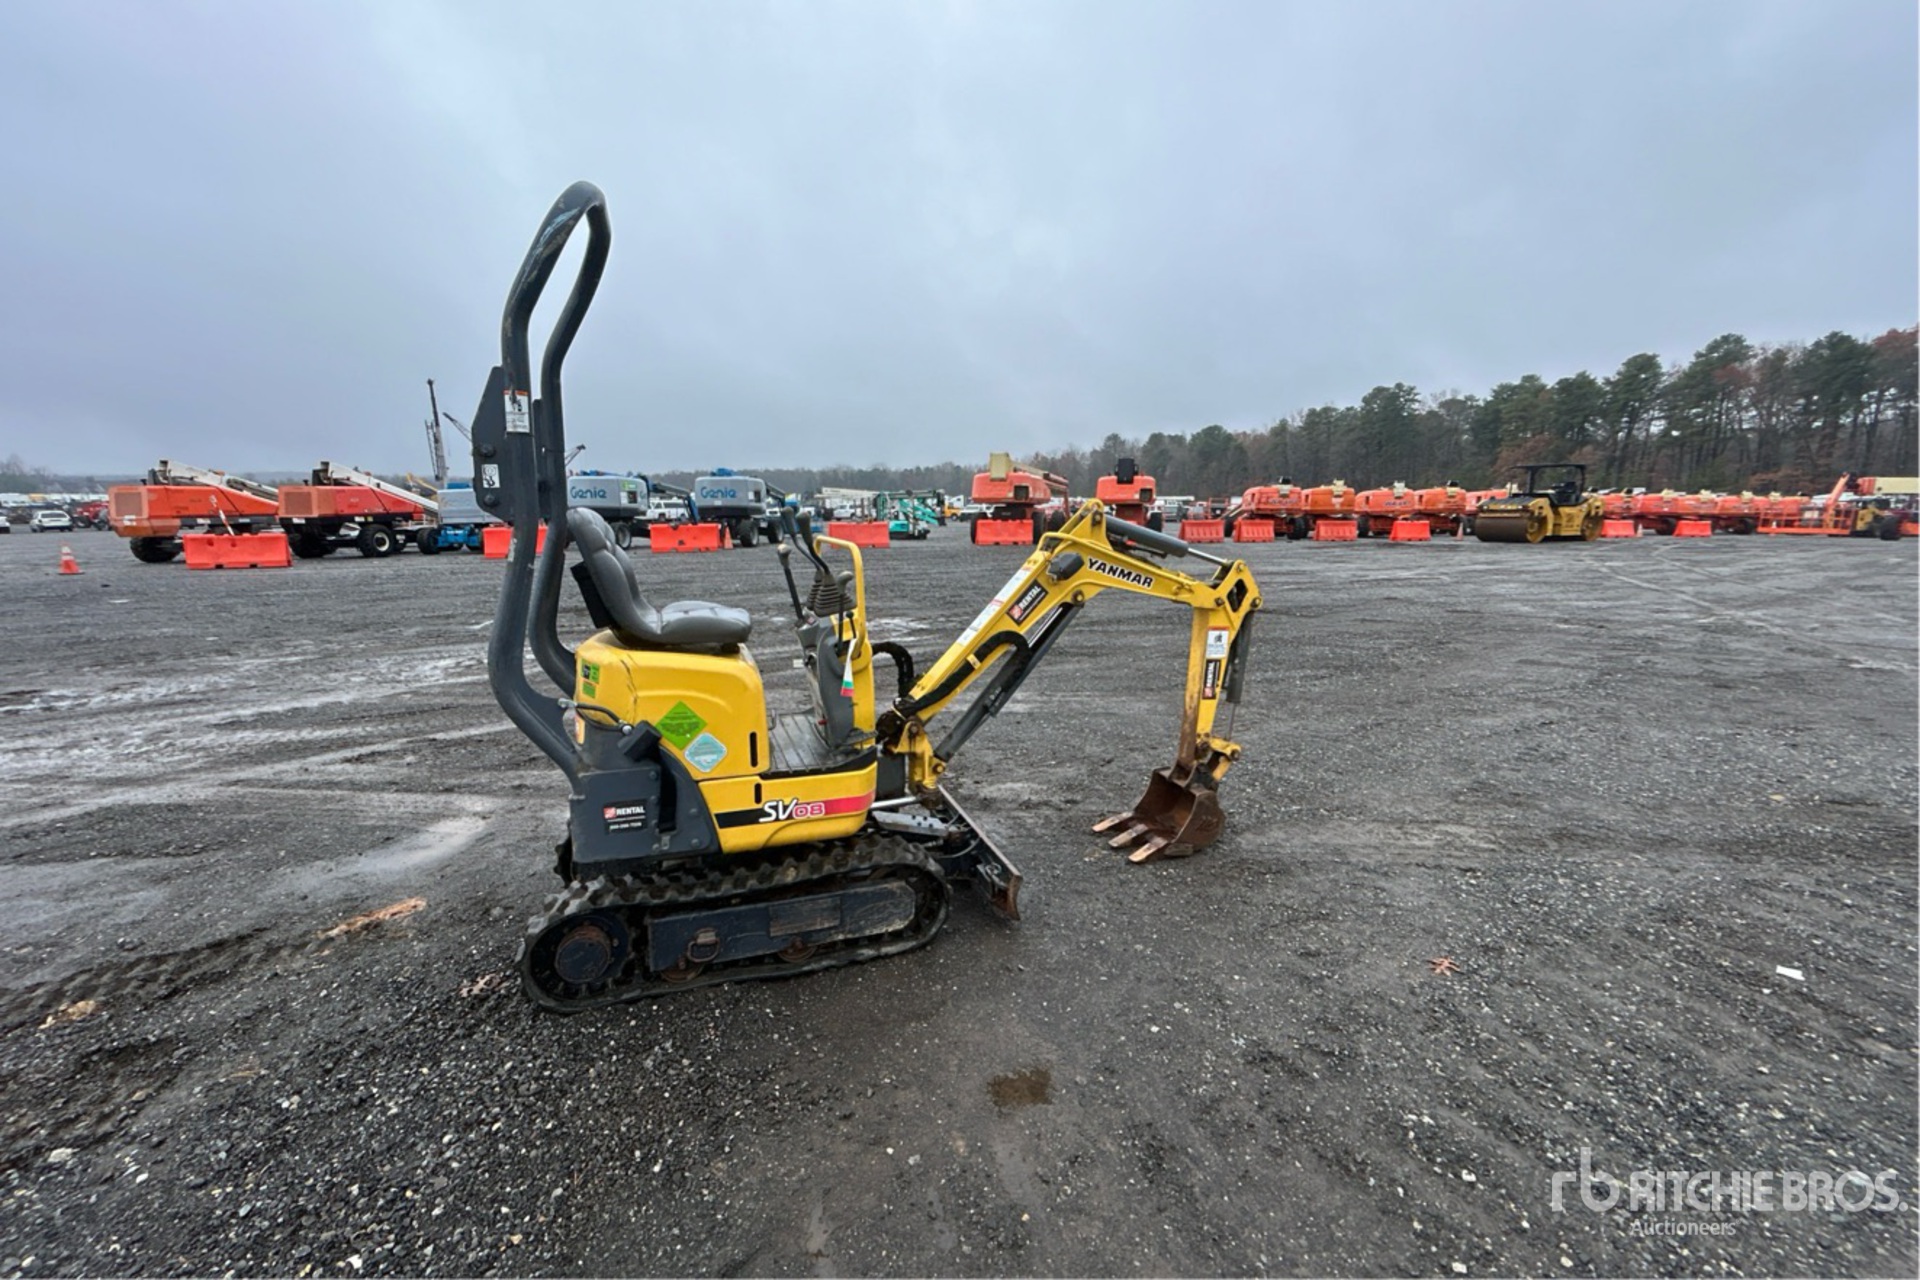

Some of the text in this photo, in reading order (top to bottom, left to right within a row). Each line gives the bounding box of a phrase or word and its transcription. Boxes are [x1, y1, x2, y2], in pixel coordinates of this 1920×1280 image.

[570, 486, 607, 499] Genie
[701, 486, 737, 499] Genie
[1088, 557, 1154, 588] YANMAR
[1018, 585, 1042, 610] RENTAL
[616, 806, 646, 816] RENTAL
[759, 799, 825, 823] SV08
